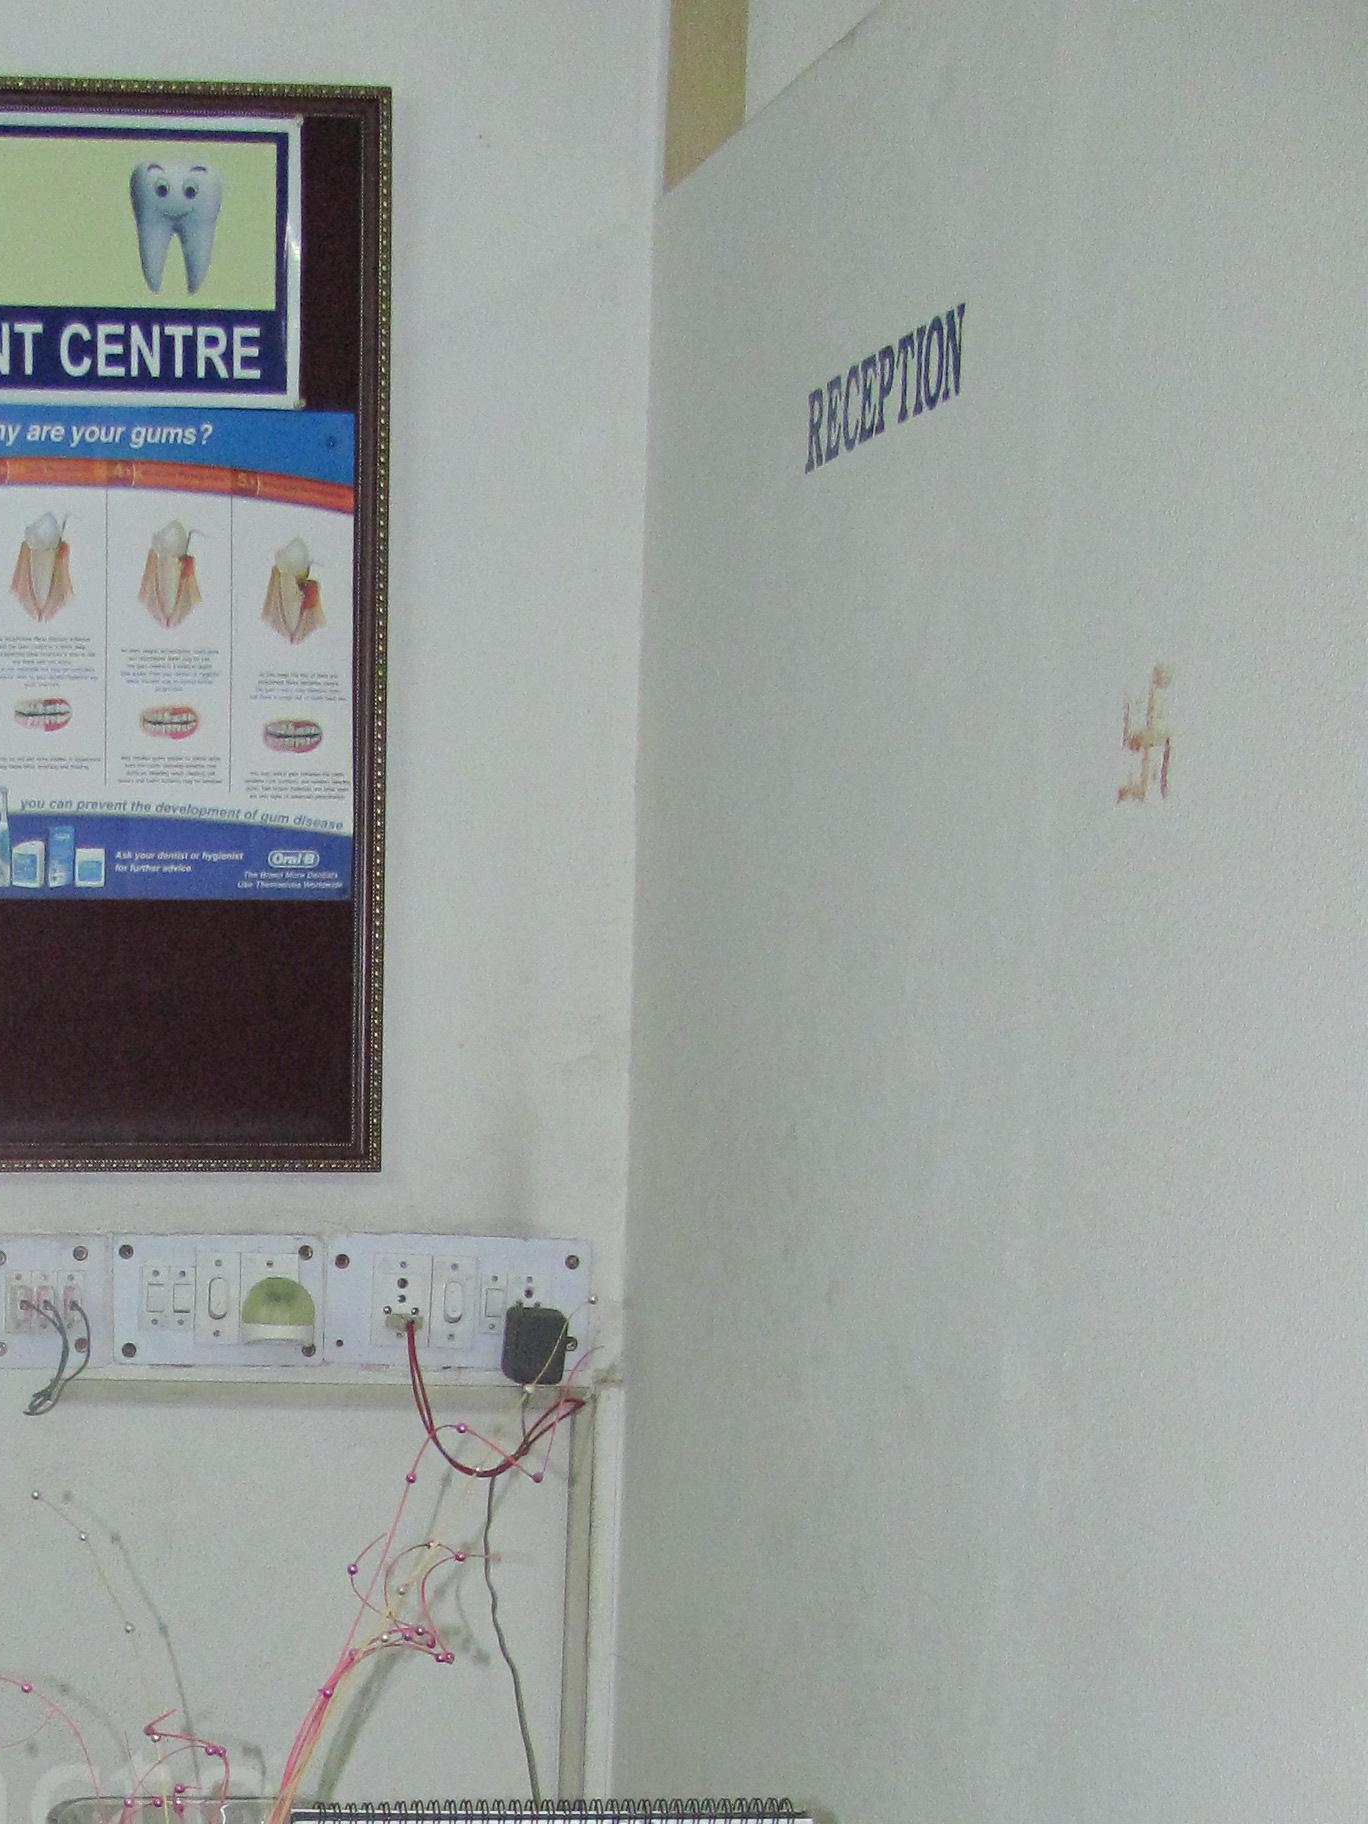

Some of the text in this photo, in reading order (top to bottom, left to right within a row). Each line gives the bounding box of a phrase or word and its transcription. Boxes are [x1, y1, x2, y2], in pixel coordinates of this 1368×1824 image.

[59, 323, 262, 380] CENTRE
[804, 303, 966, 475] RECEPTION
[27, 423, 64, 442] are
[70, 424, 125, 449] your
[130, 422, 213, 449] gums?
[19, 799, 44, 812] you
[49, 800, 72, 811] can
[76, 800, 128, 814] prevent
[131, 800, 151, 812] the
[155, 801, 240, 822] development
[243, 807, 258, 821] of
[260, 812, 291, 825] gum
[293, 814, 344, 831] disease
[115, 851, 132, 859] Ask
[135, 852, 156, 861] your
[157, 850, 188, 860] dentist
[201, 850, 244, 862] hygienist
